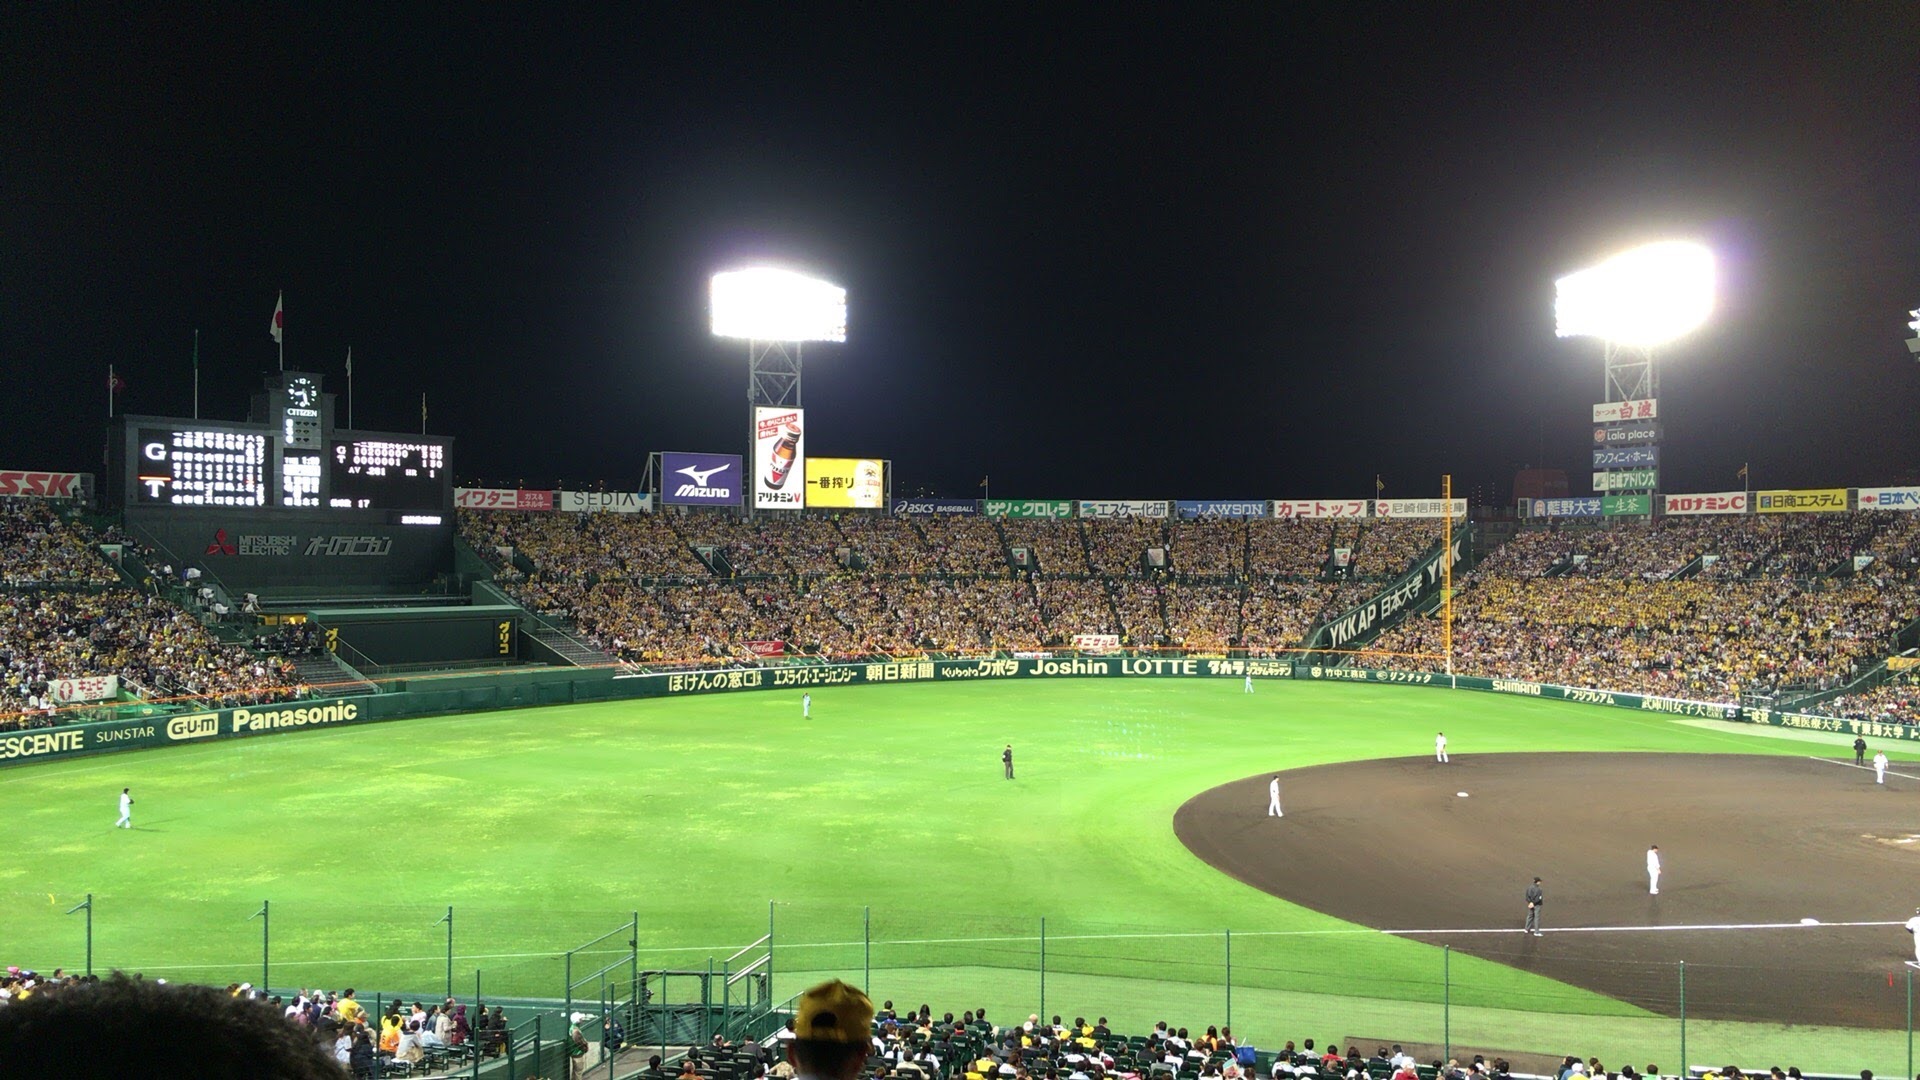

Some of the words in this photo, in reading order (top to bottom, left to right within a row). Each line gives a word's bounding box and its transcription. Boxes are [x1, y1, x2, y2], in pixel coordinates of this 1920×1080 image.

[287, 408, 318, 418] CITIZEN
[1628, 430, 1655, 441] place
[145, 442, 167, 461] G
[0, 472, 76, 497] SSK
[145, 480, 165, 498] T
[807, 476, 855, 489] 一番搾り
[457, 490, 515, 505] イワタニ
[674, 484, 730, 498] MIZUNO
[758, 492, 801, 503] アリナミンV
[1879, 491, 1920, 505] 日本ペ
[1392, 502, 1465, 514] 尼崎信用金庫
[1547, 500, 1600, 516] 藍野大学
[1667, 496, 1745, 511] オロナミンC
[1773, 494, 1844, 508] 日商エステム
[987, 502, 1071, 517] サン・クロレラ
[1098, 502, 1167, 516] エスケー化研
[1197, 504, 1264, 516] LAWSON
[1278, 502, 1363, 516] カニトップ
[239, 536, 297, 546] MITSUBISHI
[239, 546, 290, 556] ELECTRIC
[1380, 573, 1423, 620] 日本大学
[325, 627, 339, 655] グリ
[499, 621, 511, 654] グリコ
[866, 663, 934, 681] 朝日新聞
[942, 667, 978, 678] Kubota
[978, 660, 1019, 676] クボタ
[1030, 659, 1108, 675] Joshin
[1122, 659, 1197, 675] LOTTE
[1208, 661, 1245, 675] タカラ
[1325, 668, 1367, 679] 竹中工務店
[1389, 671, 1431, 683] リンテック
[78, 678, 107, 692] キューピー
[1492, 680, 1541, 695] SHIMANO
[232, 700, 357, 733] Panasonic
[1781, 714, 1843, 732] 天理医療大学
[96, 726, 155, 743] SUNSTAR
